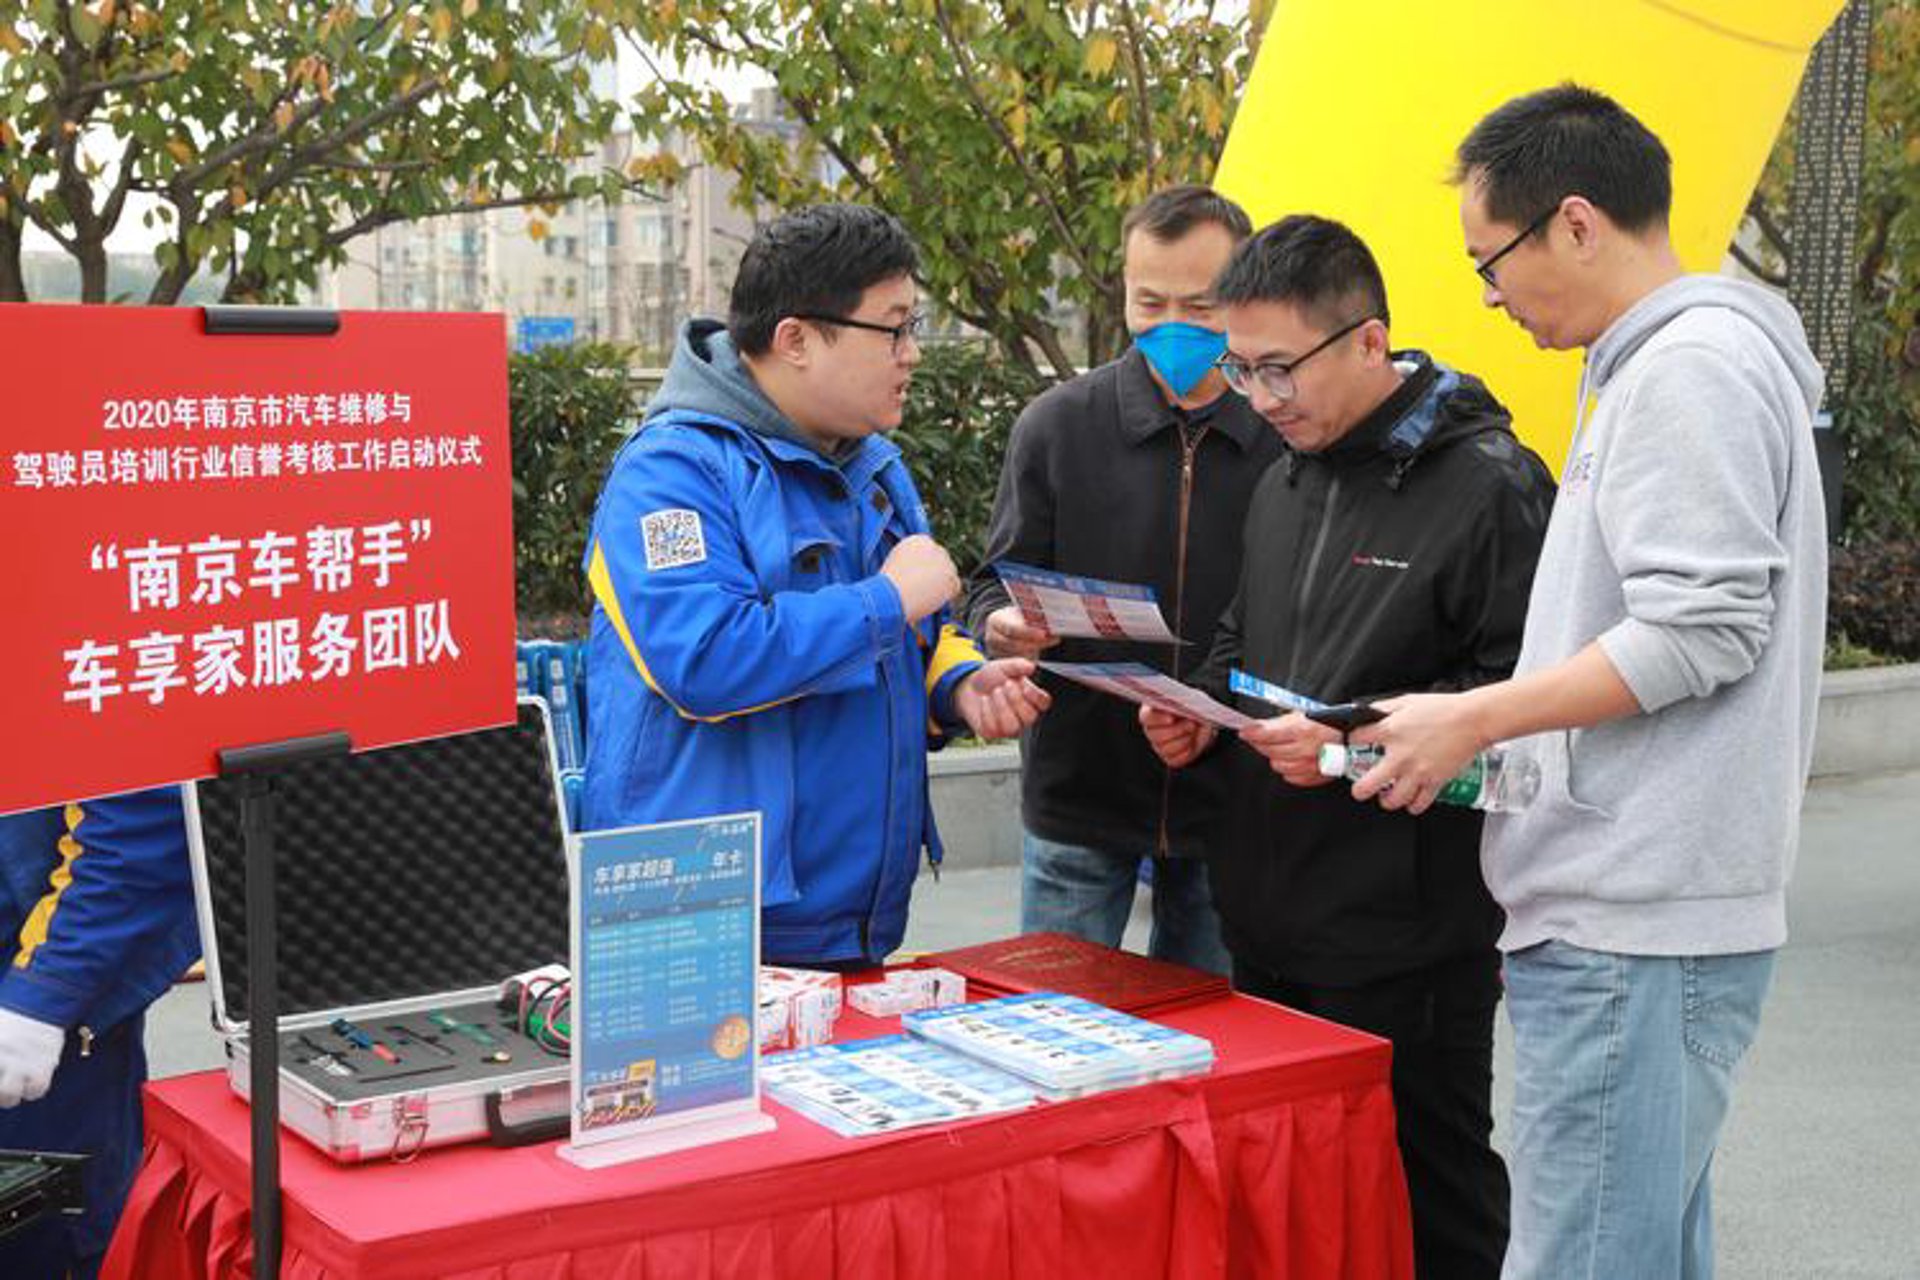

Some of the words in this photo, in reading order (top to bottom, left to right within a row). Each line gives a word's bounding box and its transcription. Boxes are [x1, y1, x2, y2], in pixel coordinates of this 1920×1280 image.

[103, 392, 411, 430] 2020年南京市汽车维修与
[12, 434, 482, 489] 驾驶员培训行业信誉考核工作启动仪式
[91, 518, 432, 612] “南京车帮手”
[63, 599, 460, 713] 车享家服务团队
